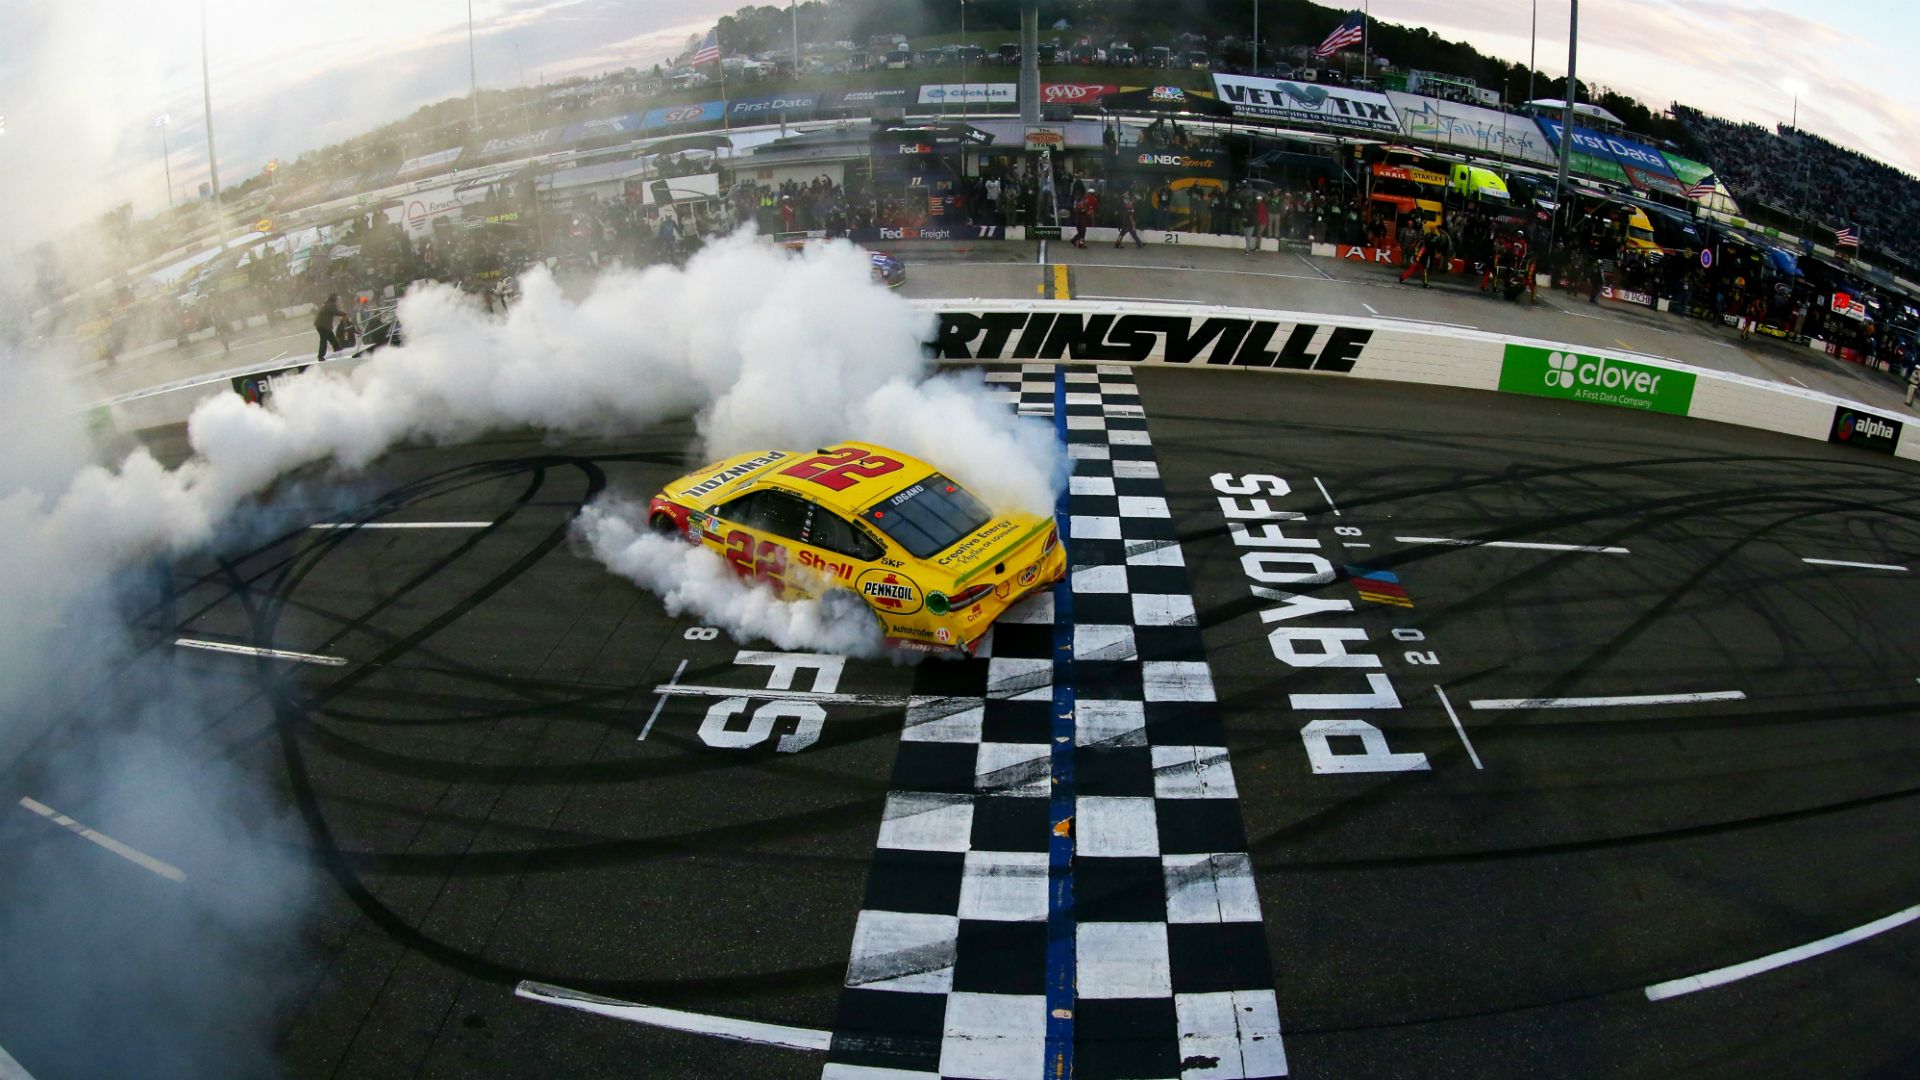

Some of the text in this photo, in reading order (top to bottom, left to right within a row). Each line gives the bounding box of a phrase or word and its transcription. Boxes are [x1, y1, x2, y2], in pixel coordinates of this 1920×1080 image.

[950, 88, 1008, 97] ClickList
[1046, 85, 1084, 98] AAA
[1152, 92, 1184, 100] NBC
[733, 99, 812, 113] First Data
[1221, 84, 1394, 122] VET TIX
[667, 107, 700, 121] STP
[900, 143, 932, 154] FedEx
[1605, 138, 1665, 168] Data
[1154, 155, 1215, 169] NBC Sports
[1379, 170, 1406, 180] ARRIS
[1413, 173, 1444, 183] STANLEY
[880, 227, 919, 239] FedEx
[920, 229, 950, 240] Freight
[1165, 233, 1180, 244] 21
[927, 311, 1375, 373] RTINSVILLE
[1578, 357, 1662, 394] clover
[1575, 388, 1653, 409] A First Data Company
[1855, 417, 1894, 439] alpha
[680, 449, 788, 497] PENNZOIL
[777, 447, 905, 491] 22
[890, 484, 925, 507] LOGANO
[938, 538, 980, 565] Creative
[977, 520, 1013, 539] Energy
[726, 529, 787, 592] 22
[798, 550, 853, 580] Shell
[881, 557, 905, 568] SKF
[863, 582, 913, 600] PENNZOIL
[892, 625, 934, 637] Autotrader
[1210, 472, 1432, 774] PLAYOFFS
[683, 627, 719, 640] 8
[697, 650, 848, 753] FS
